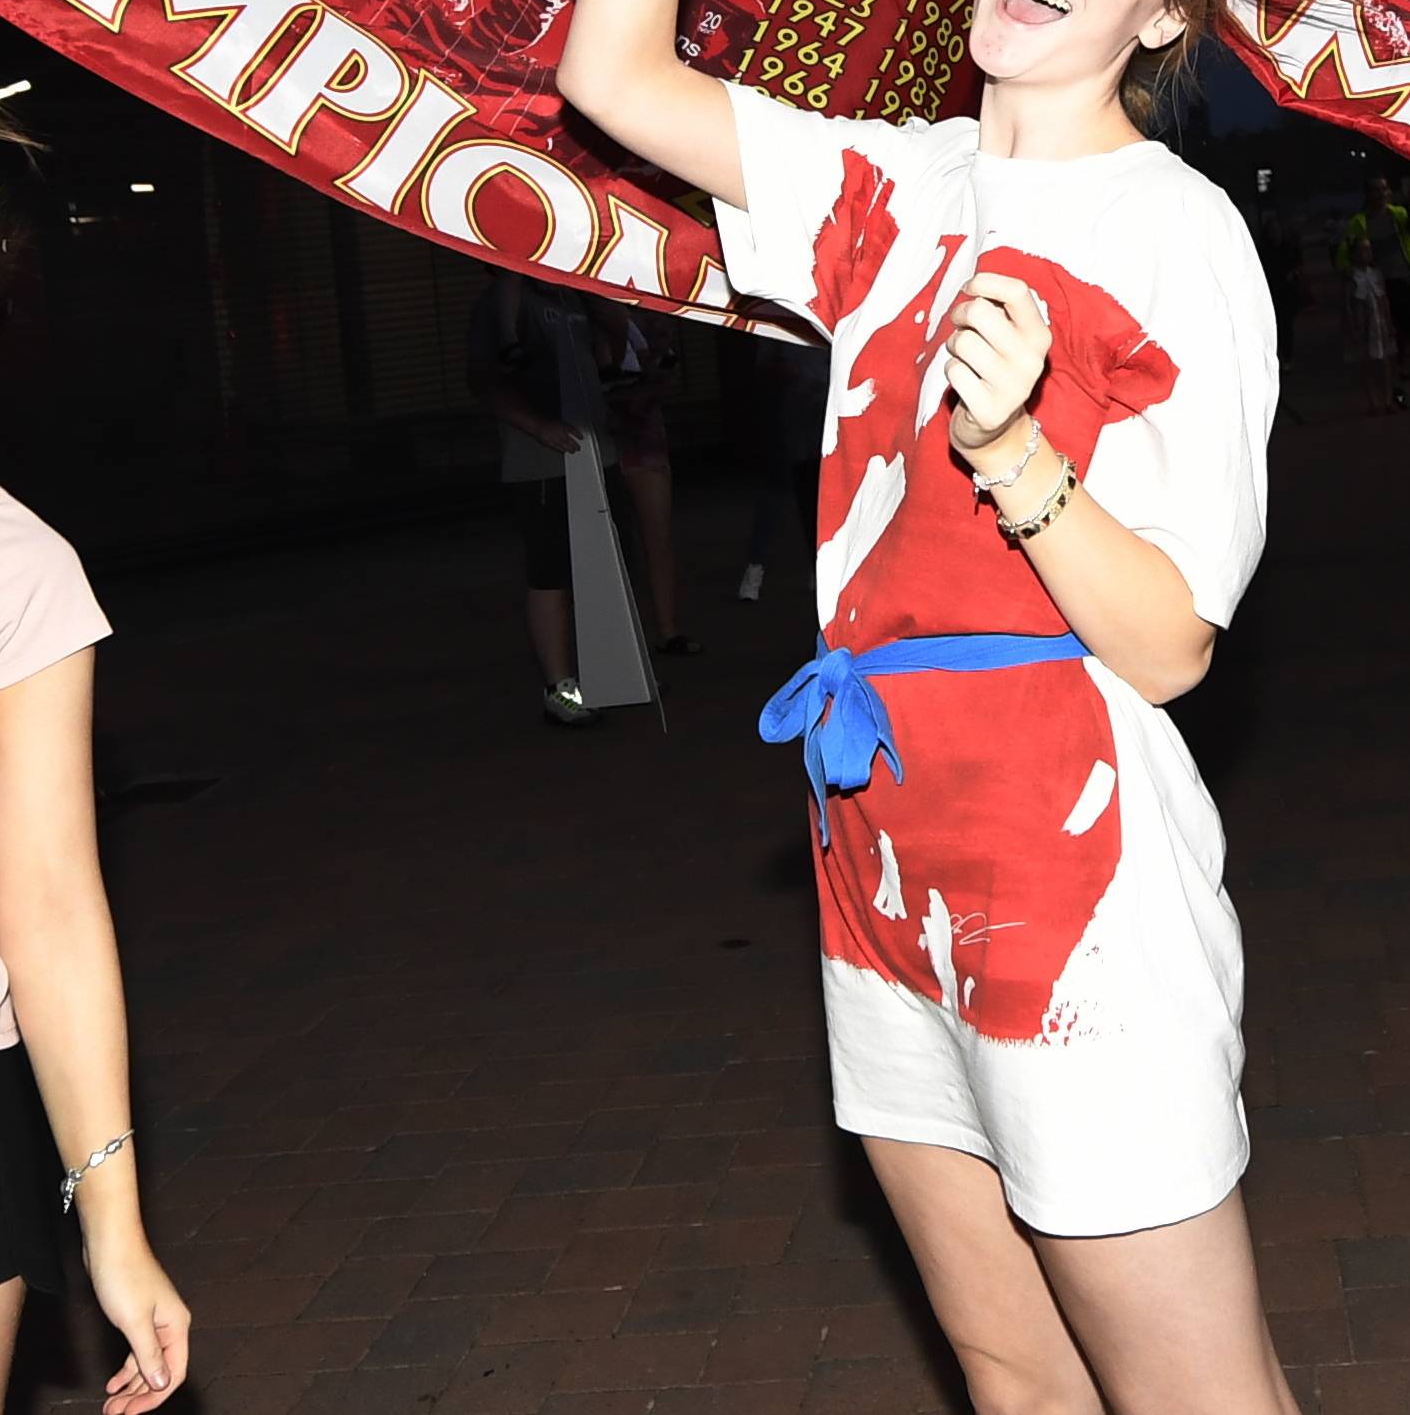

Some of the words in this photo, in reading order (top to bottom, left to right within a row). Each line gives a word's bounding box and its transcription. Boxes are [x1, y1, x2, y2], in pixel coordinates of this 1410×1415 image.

[700, 12, 722, 29] 20
[753, 21, 845, 78] 1964
[738, 48, 831, 108] 1966
[879, 48, 941, 121] 1983
[894, 19, 951, 94] 1982
[865, 79, 914, 127] 198
